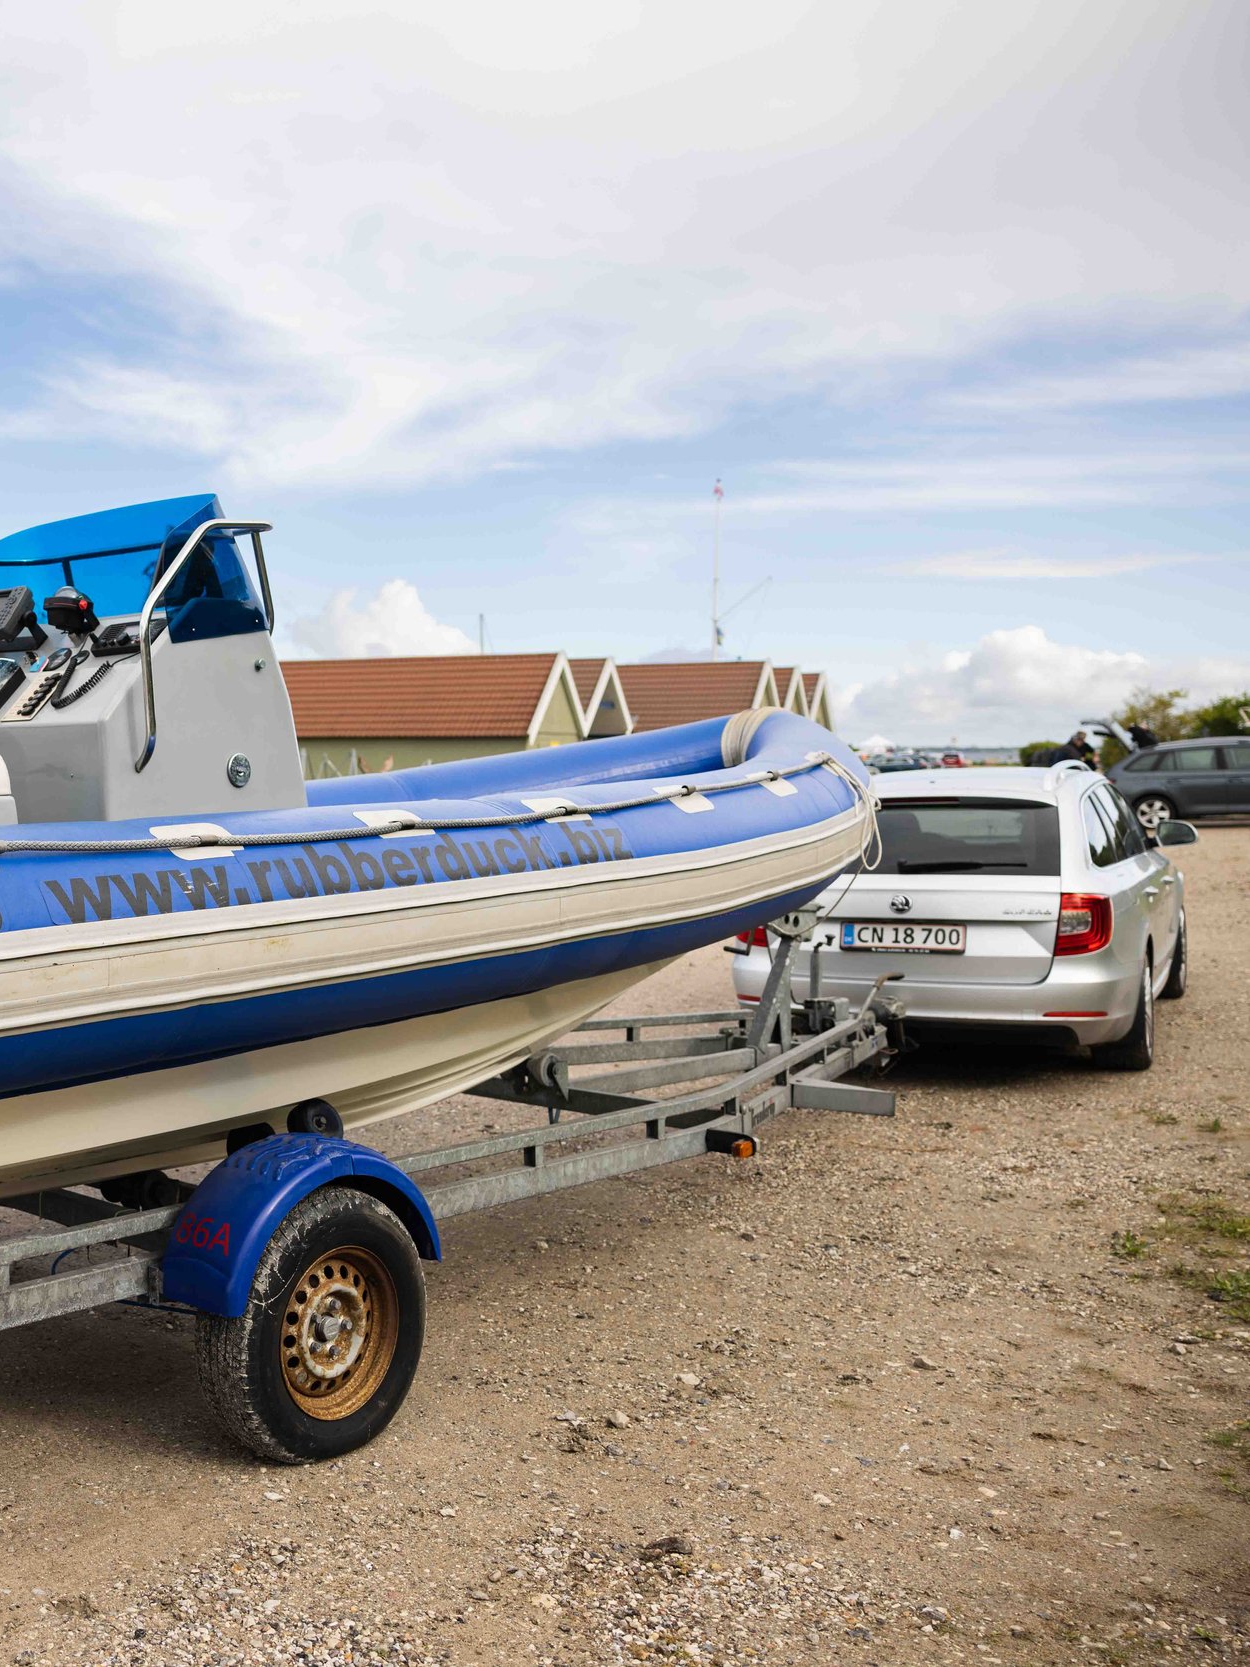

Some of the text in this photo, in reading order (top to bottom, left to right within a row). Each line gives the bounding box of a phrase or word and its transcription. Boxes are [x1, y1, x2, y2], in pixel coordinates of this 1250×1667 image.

[857, 927, 960, 946] CN 18 700
[176, 1212, 230, 1257] 86A
